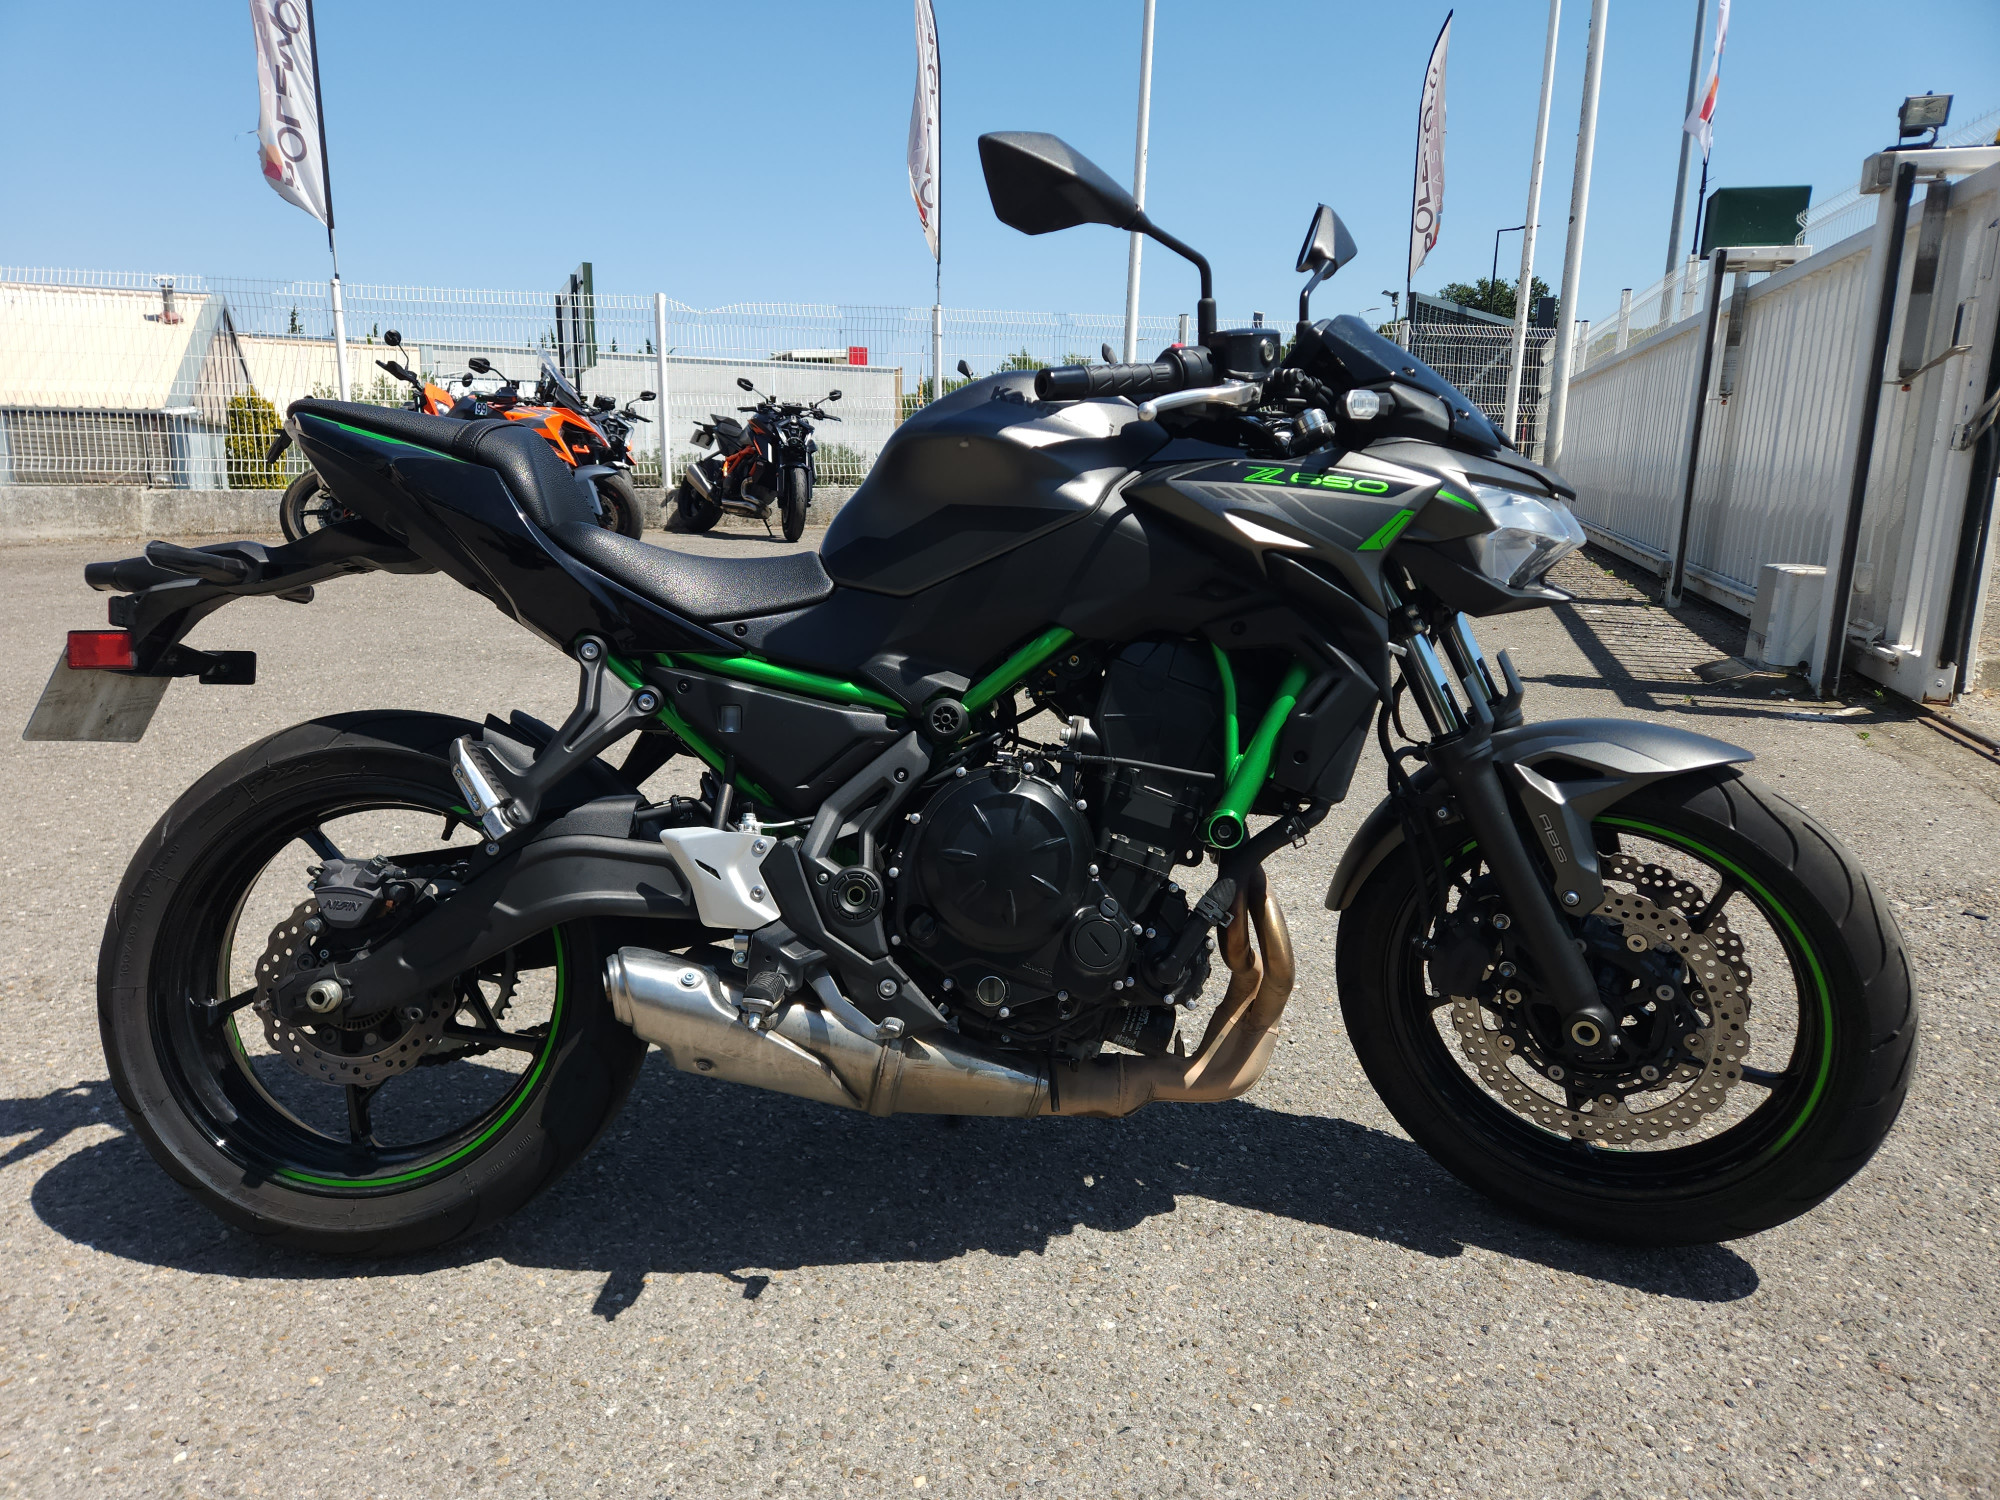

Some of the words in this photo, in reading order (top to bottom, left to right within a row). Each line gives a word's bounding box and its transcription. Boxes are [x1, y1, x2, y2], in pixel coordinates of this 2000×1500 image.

[1243, 465, 1286, 485] Z
[1290, 472, 1388, 493] 650
[1539, 814, 1567, 863] ABS
